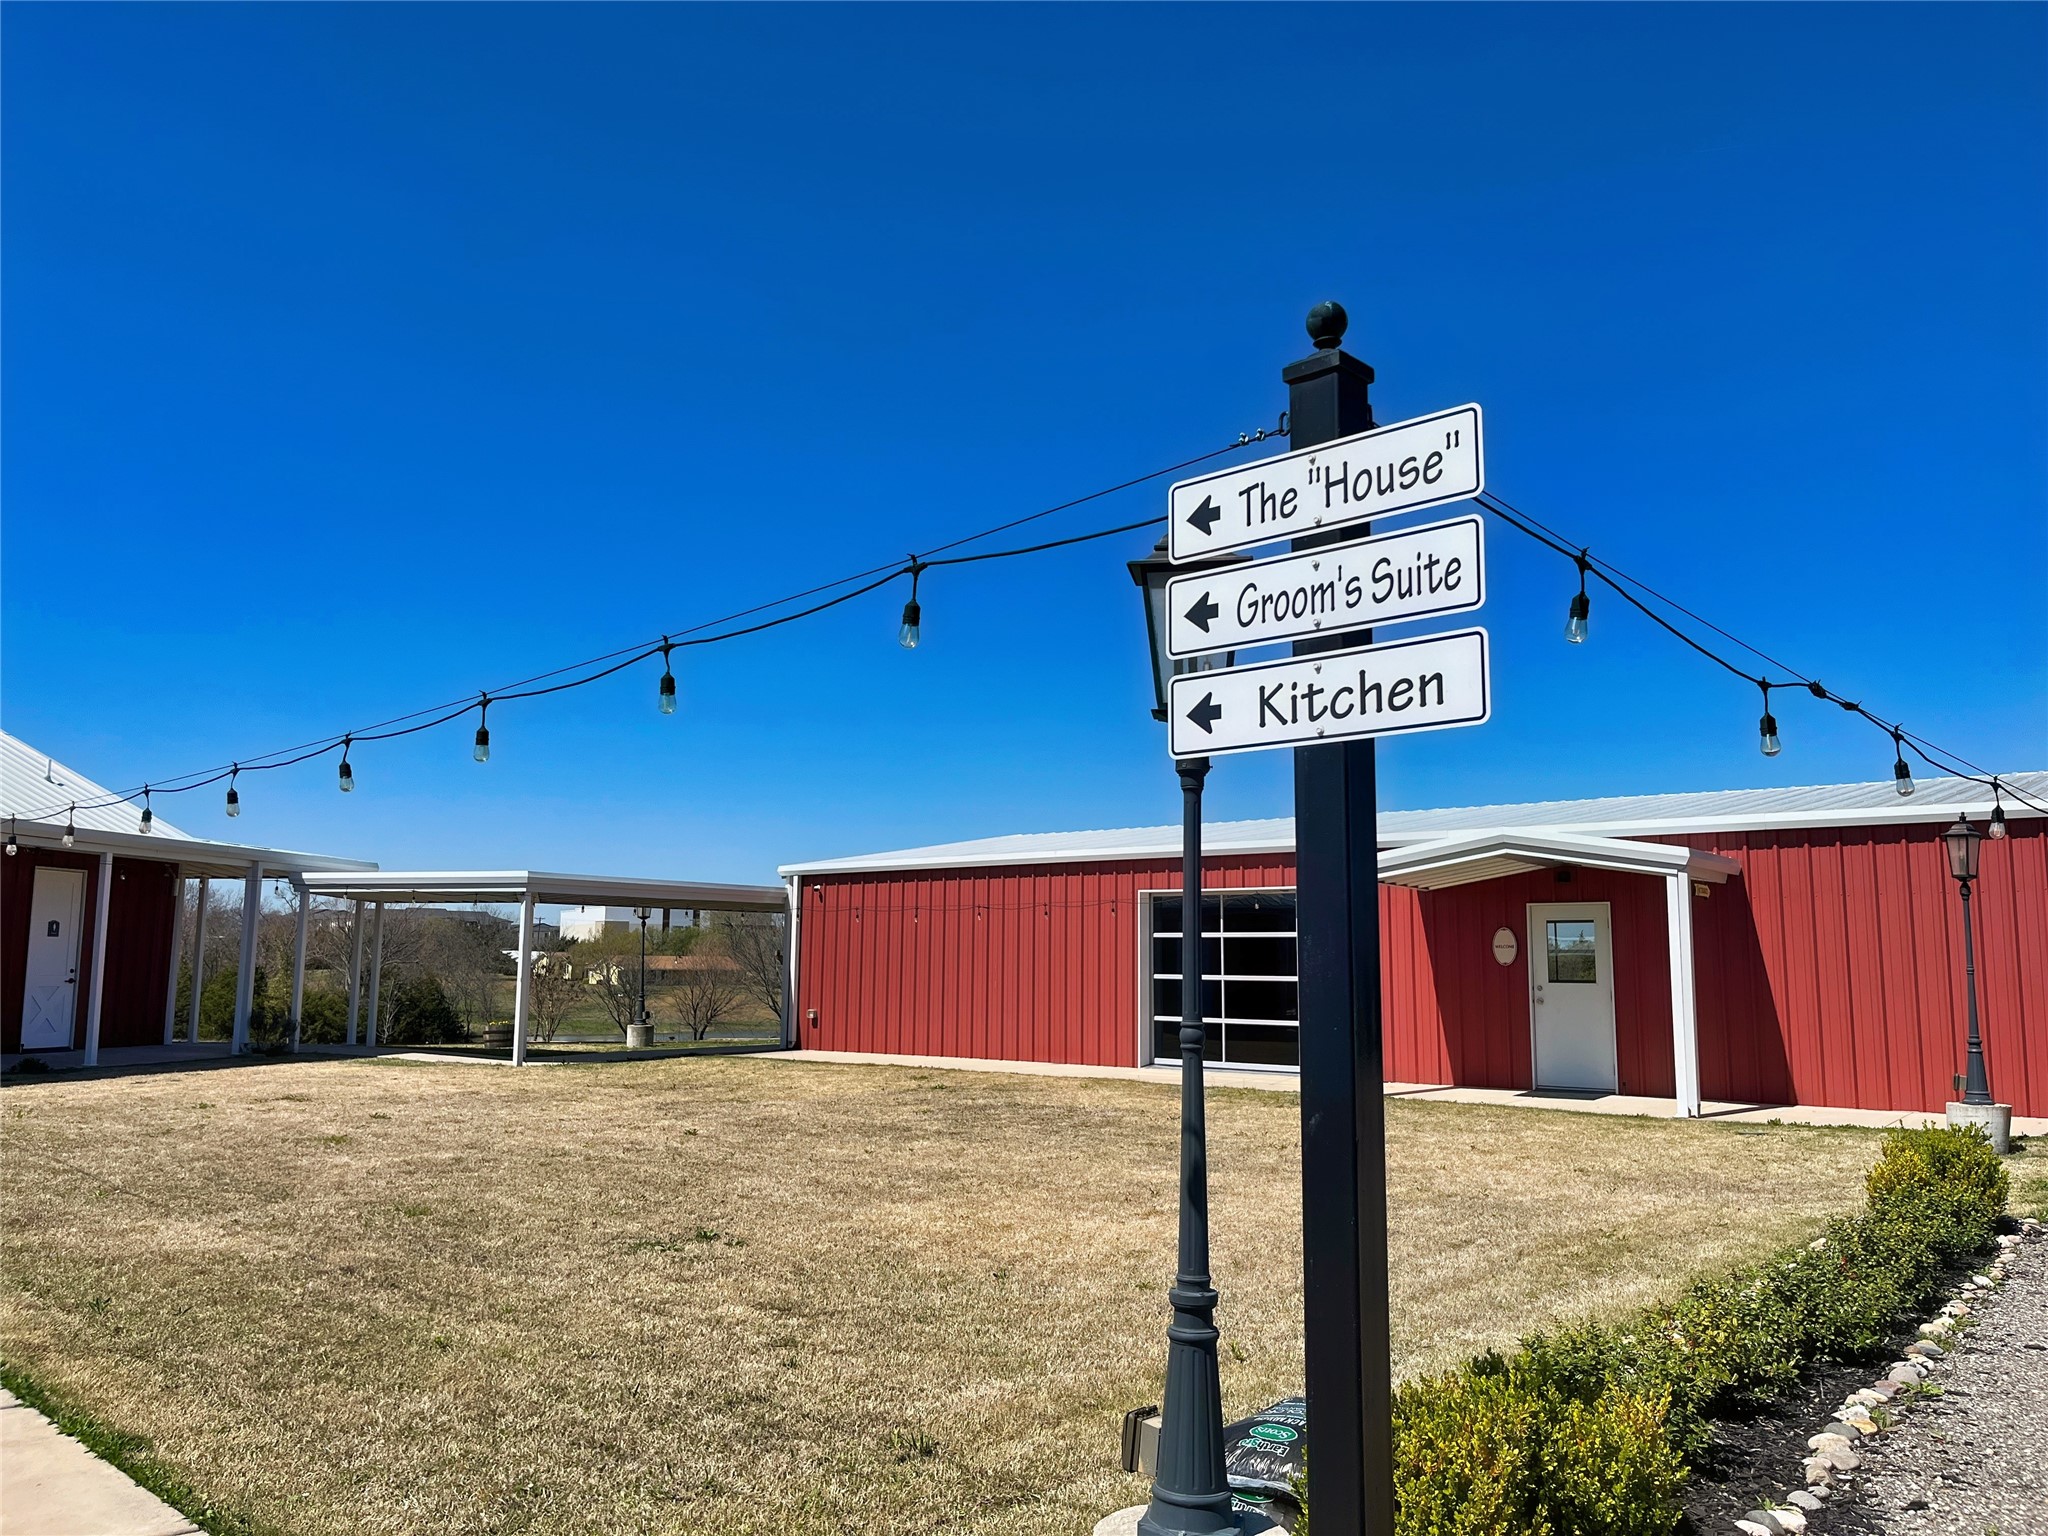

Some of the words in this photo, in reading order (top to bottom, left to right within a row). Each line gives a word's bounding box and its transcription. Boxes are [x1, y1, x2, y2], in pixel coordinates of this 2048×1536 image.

[1238, 481, 1298, 527] The
[1308, 430, 1460, 508] "House"
[1236, 565, 1362, 628] Groom's
[1371, 551, 1462, 604] Suite
[1259, 670, 1444, 728] Kitchen
[1237, 1437, 1290, 1457] Earthgro
[1255, 1426, 1292, 1439] Scotts
